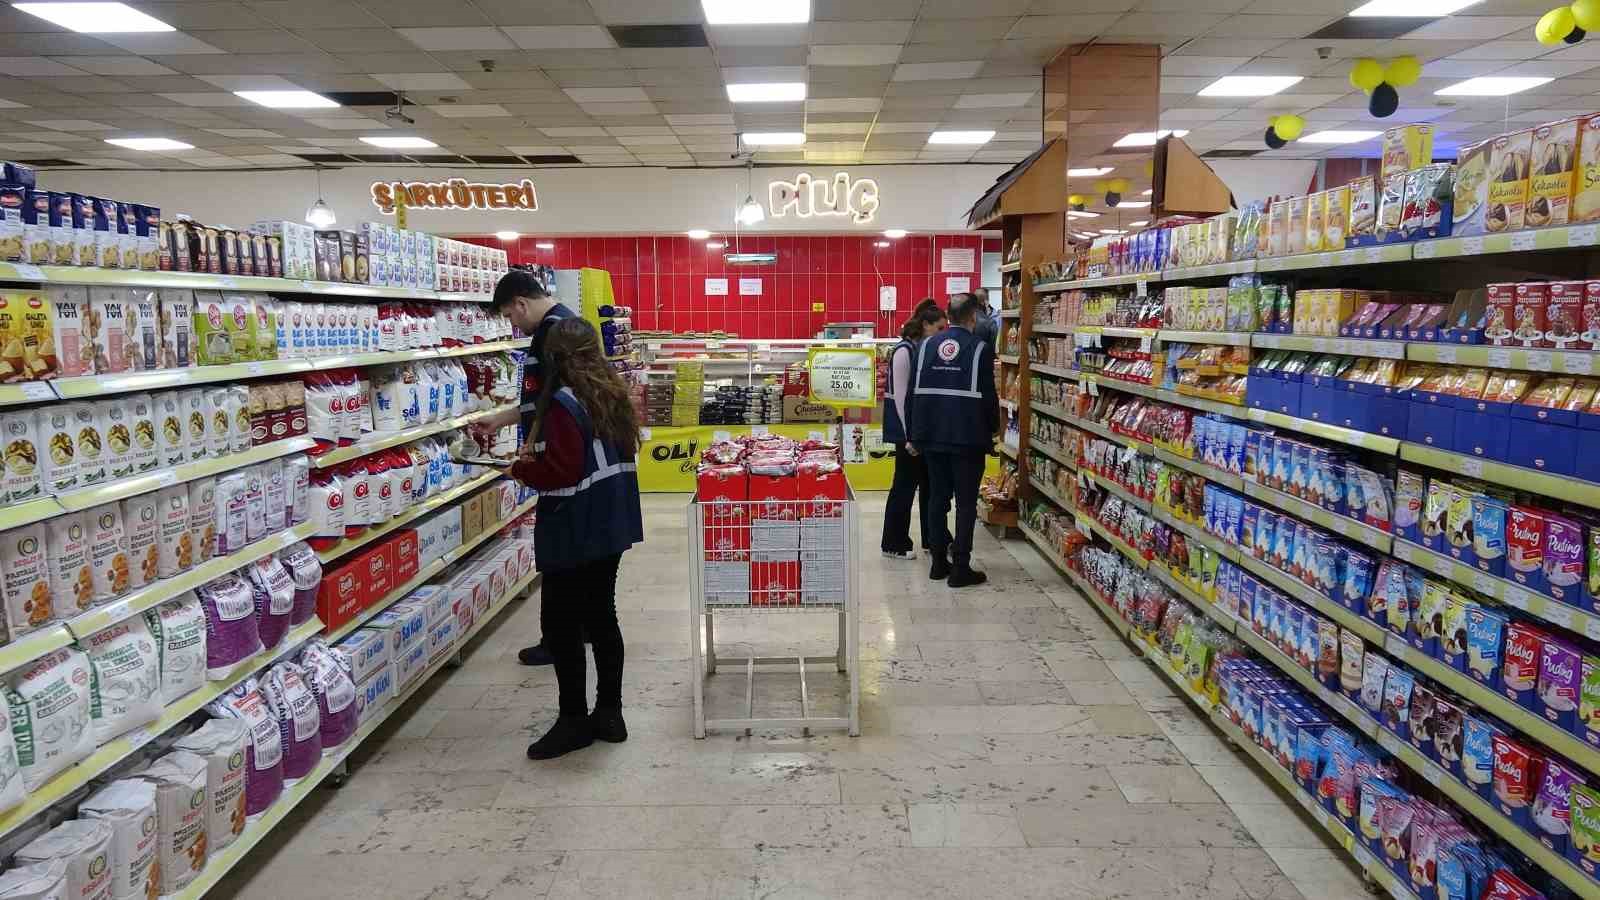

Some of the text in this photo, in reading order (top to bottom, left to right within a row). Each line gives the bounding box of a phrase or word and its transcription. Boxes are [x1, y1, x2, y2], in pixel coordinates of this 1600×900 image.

[371, 178, 538, 214] ŞARKÜTERİ
[769, 172, 880, 224] PİLİÇ
[831, 381, 853, 389] 25.00
[1475, 511, 1499, 534] Puding
[1512, 523, 1540, 546] Puding
[1548, 535, 1581, 559] Puding
[1469, 622, 1497, 645] Puding
[1505, 639, 1534, 665] Puding
[1543, 655, 1573, 684] Puding
[1494, 753, 1521, 782] Puding
